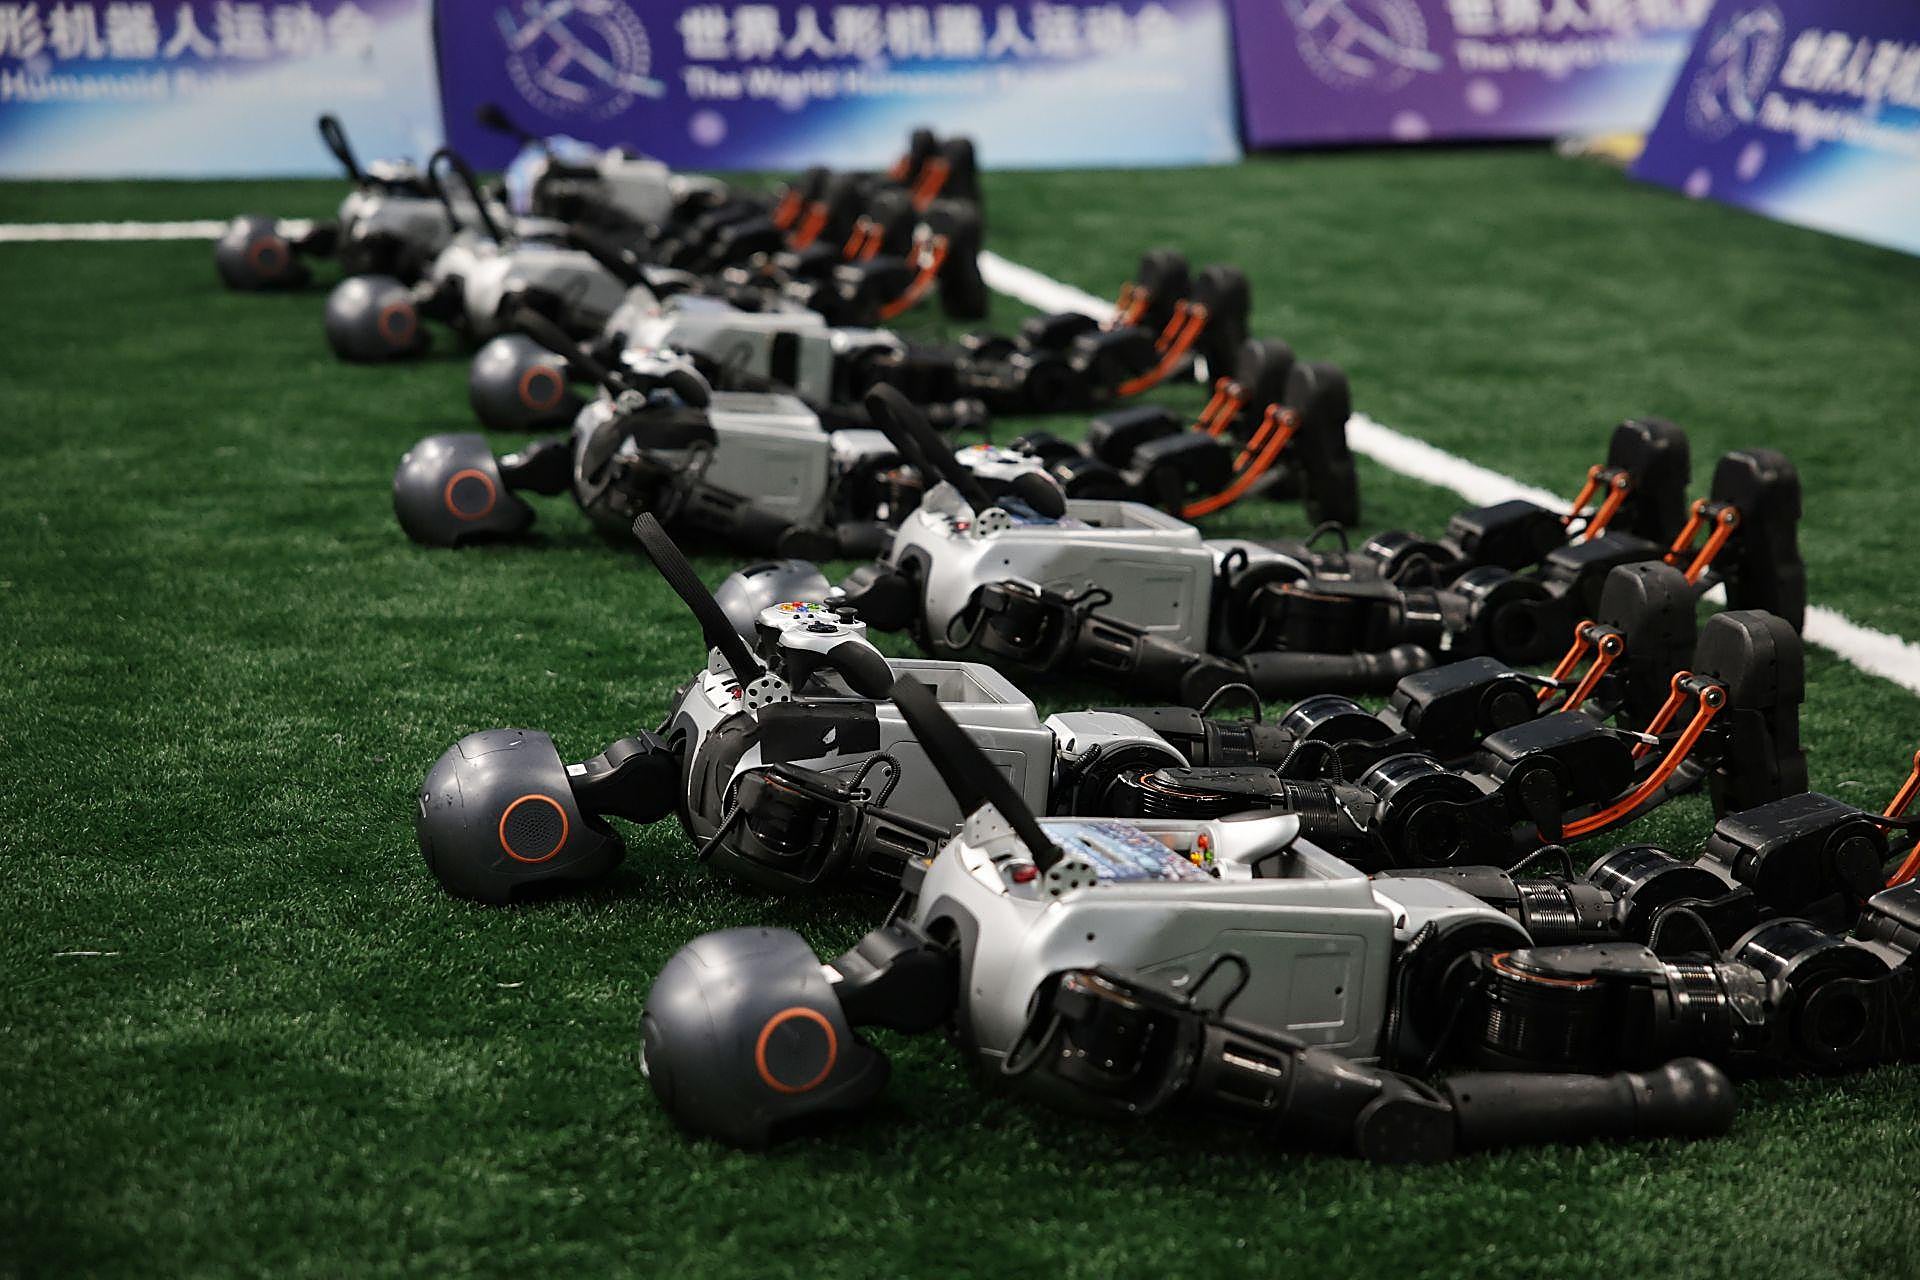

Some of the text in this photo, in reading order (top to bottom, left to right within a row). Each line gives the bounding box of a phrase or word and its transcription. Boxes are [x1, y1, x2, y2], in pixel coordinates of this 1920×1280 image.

[678, 3, 1176, 60] 世界人形机器人运动会
